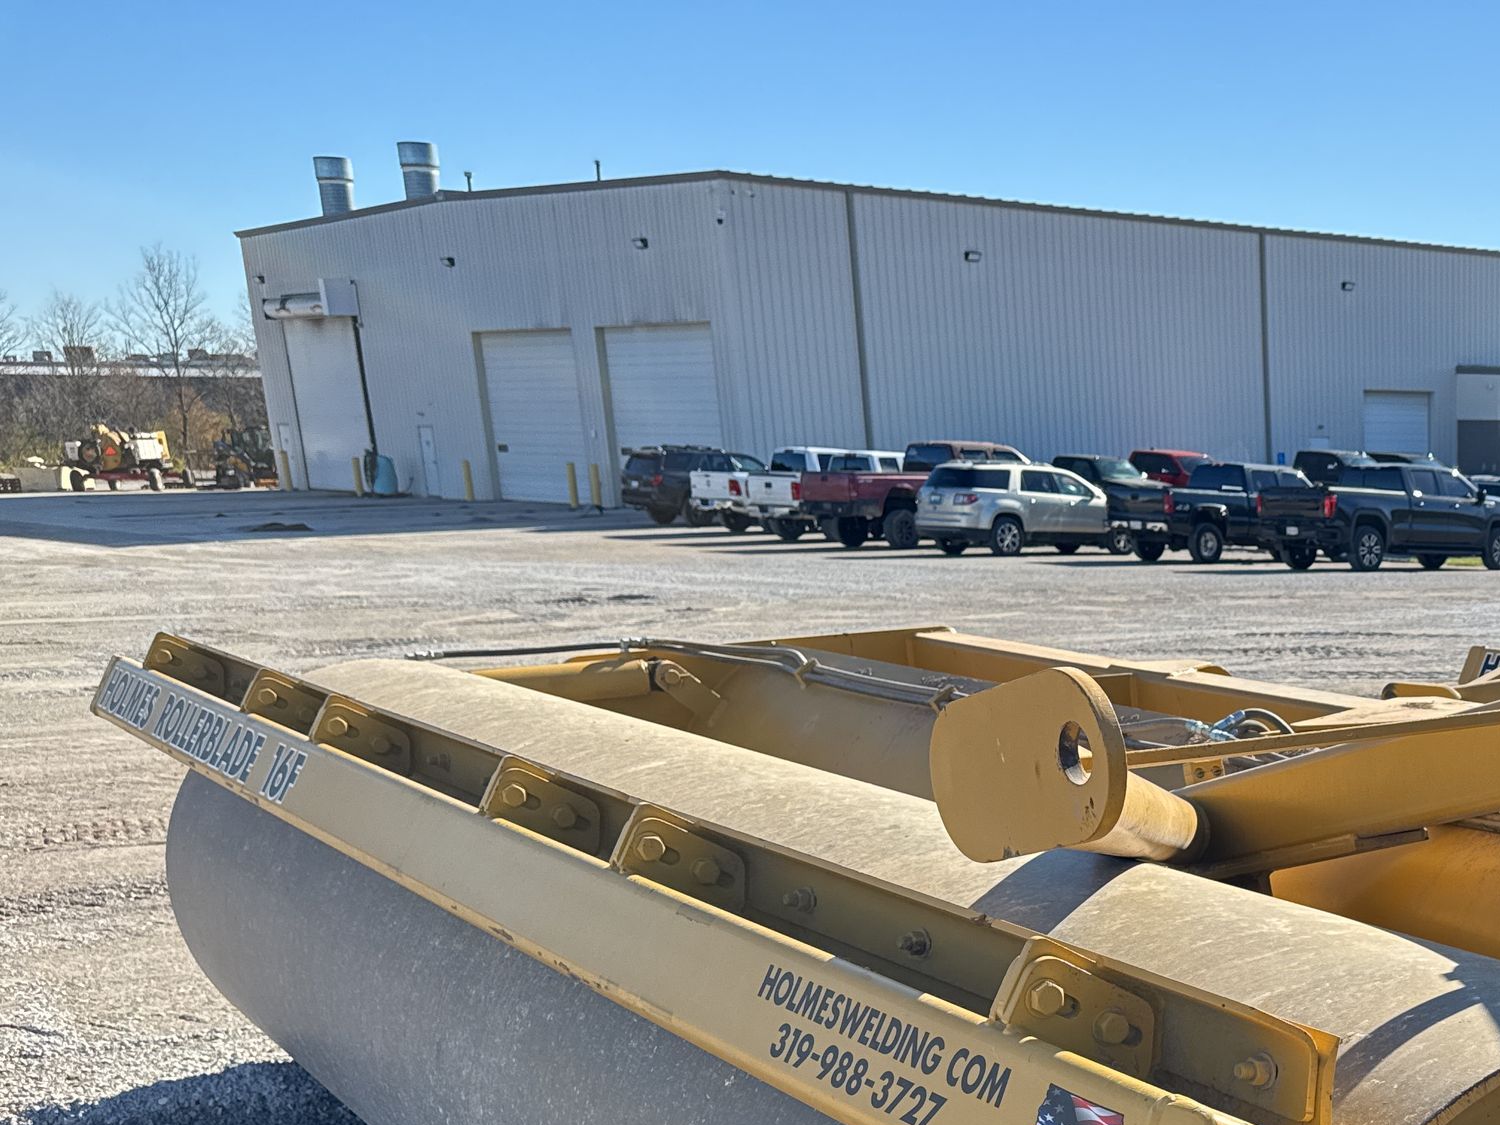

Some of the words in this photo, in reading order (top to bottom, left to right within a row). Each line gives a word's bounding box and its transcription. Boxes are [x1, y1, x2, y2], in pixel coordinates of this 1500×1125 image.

[99, 667, 161, 730] HOLMES
[152, 693, 267, 785] ROLLERBLADE
[259, 742, 308, 805] 16F
